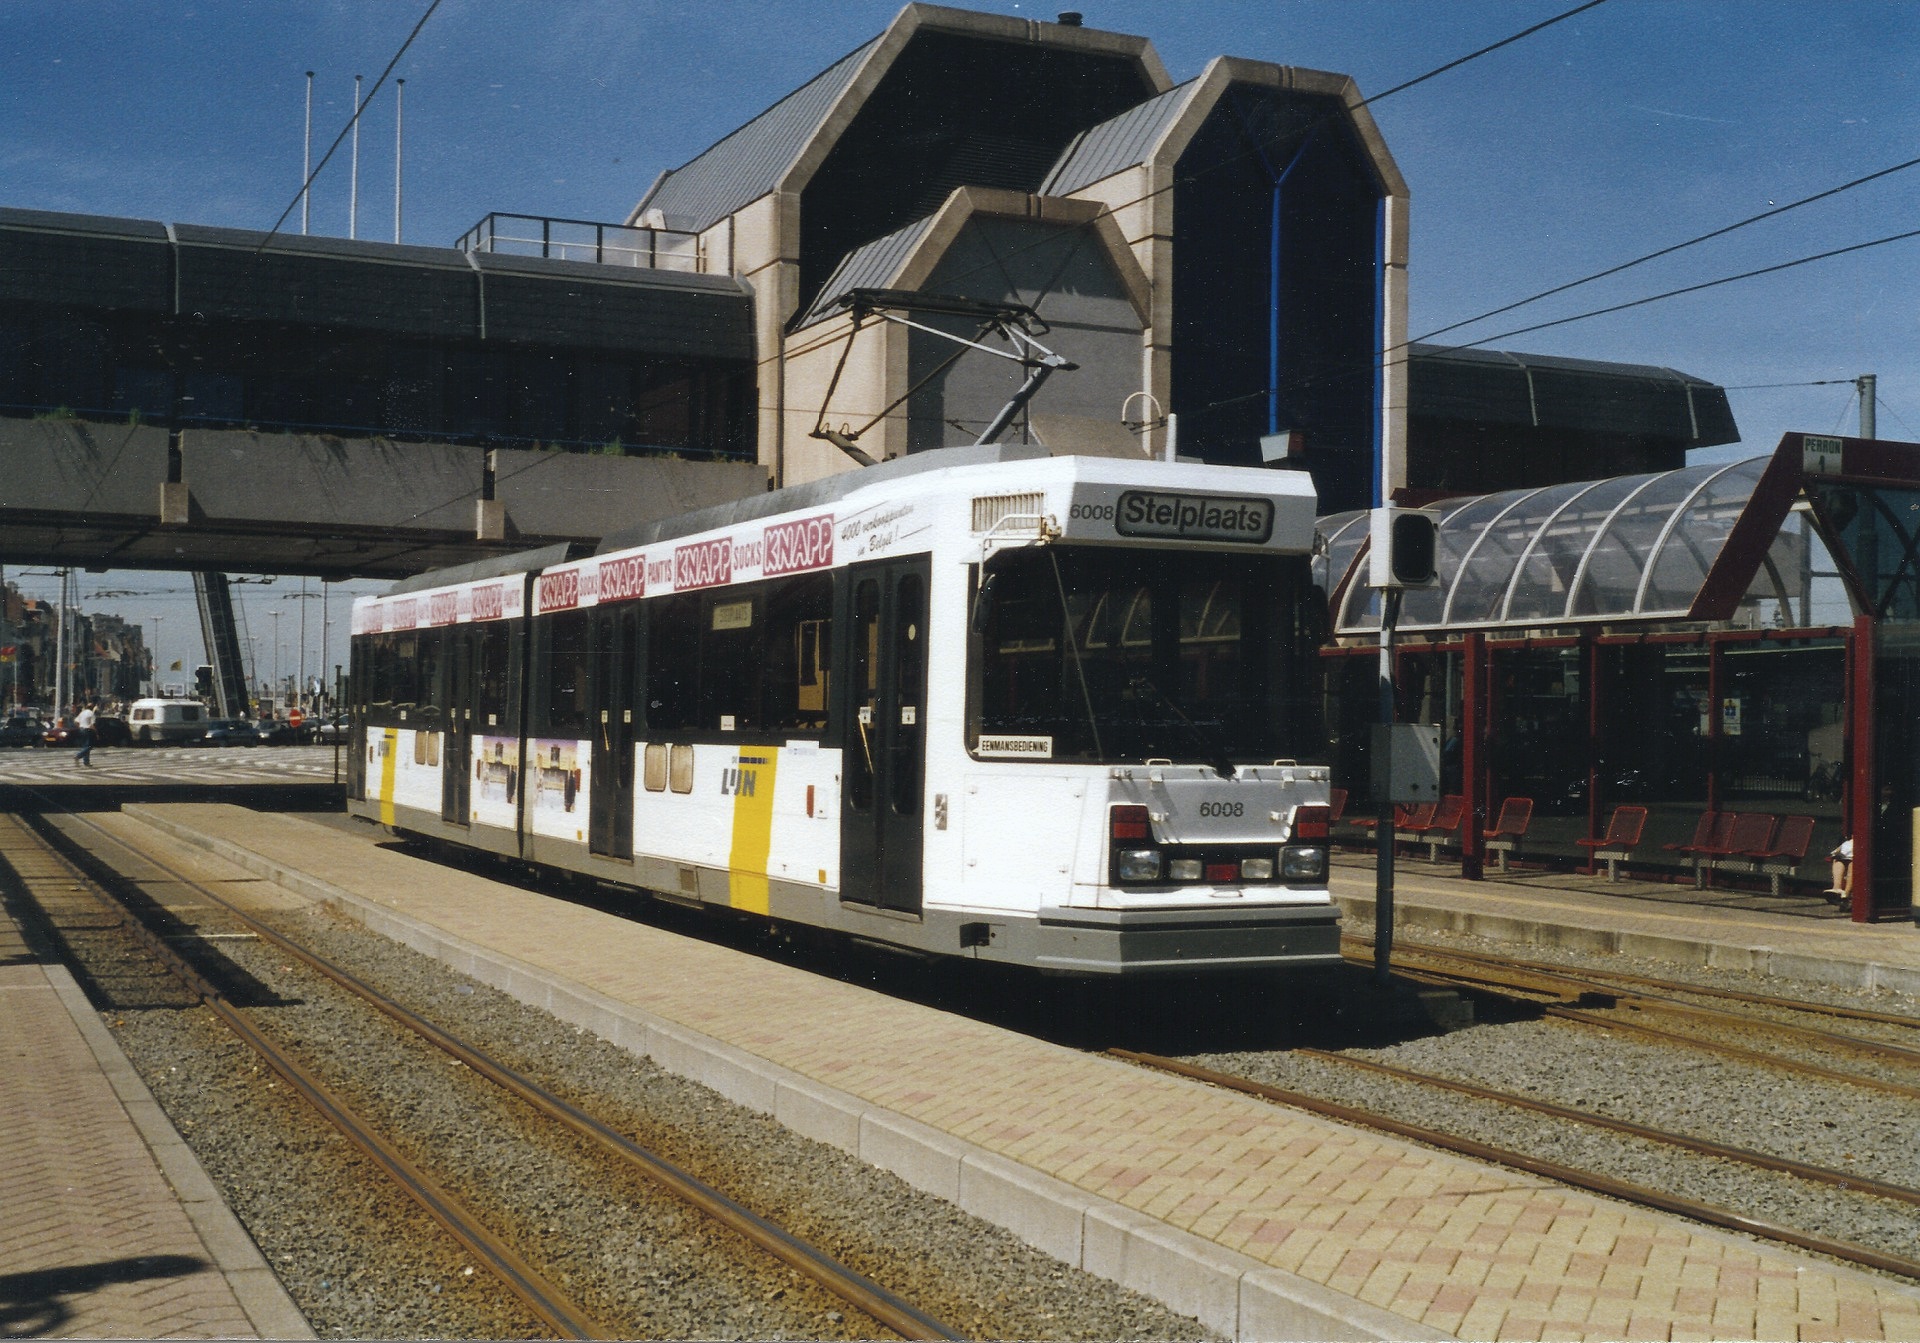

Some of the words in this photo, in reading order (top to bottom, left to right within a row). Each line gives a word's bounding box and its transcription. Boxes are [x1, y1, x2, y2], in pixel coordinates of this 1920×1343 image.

[1805, 437, 1841, 454] PERRON
[1818, 455, 1825, 473] 1
[1070, 504, 1114, 520] 6008
[1125, 494, 1262, 533] Stelplaats
[540, 570, 578, 610] KNAPP
[600, 556, 645, 600] KNAPP
[674, 539, 732, 589] KNAPP
[733, 540, 762, 571] SOCKS
[763, 517, 833, 573] KNAPP
[982, 740, 1048, 753] EENMANSBEDIENING
[1199, 802, 1244, 818] 6008
